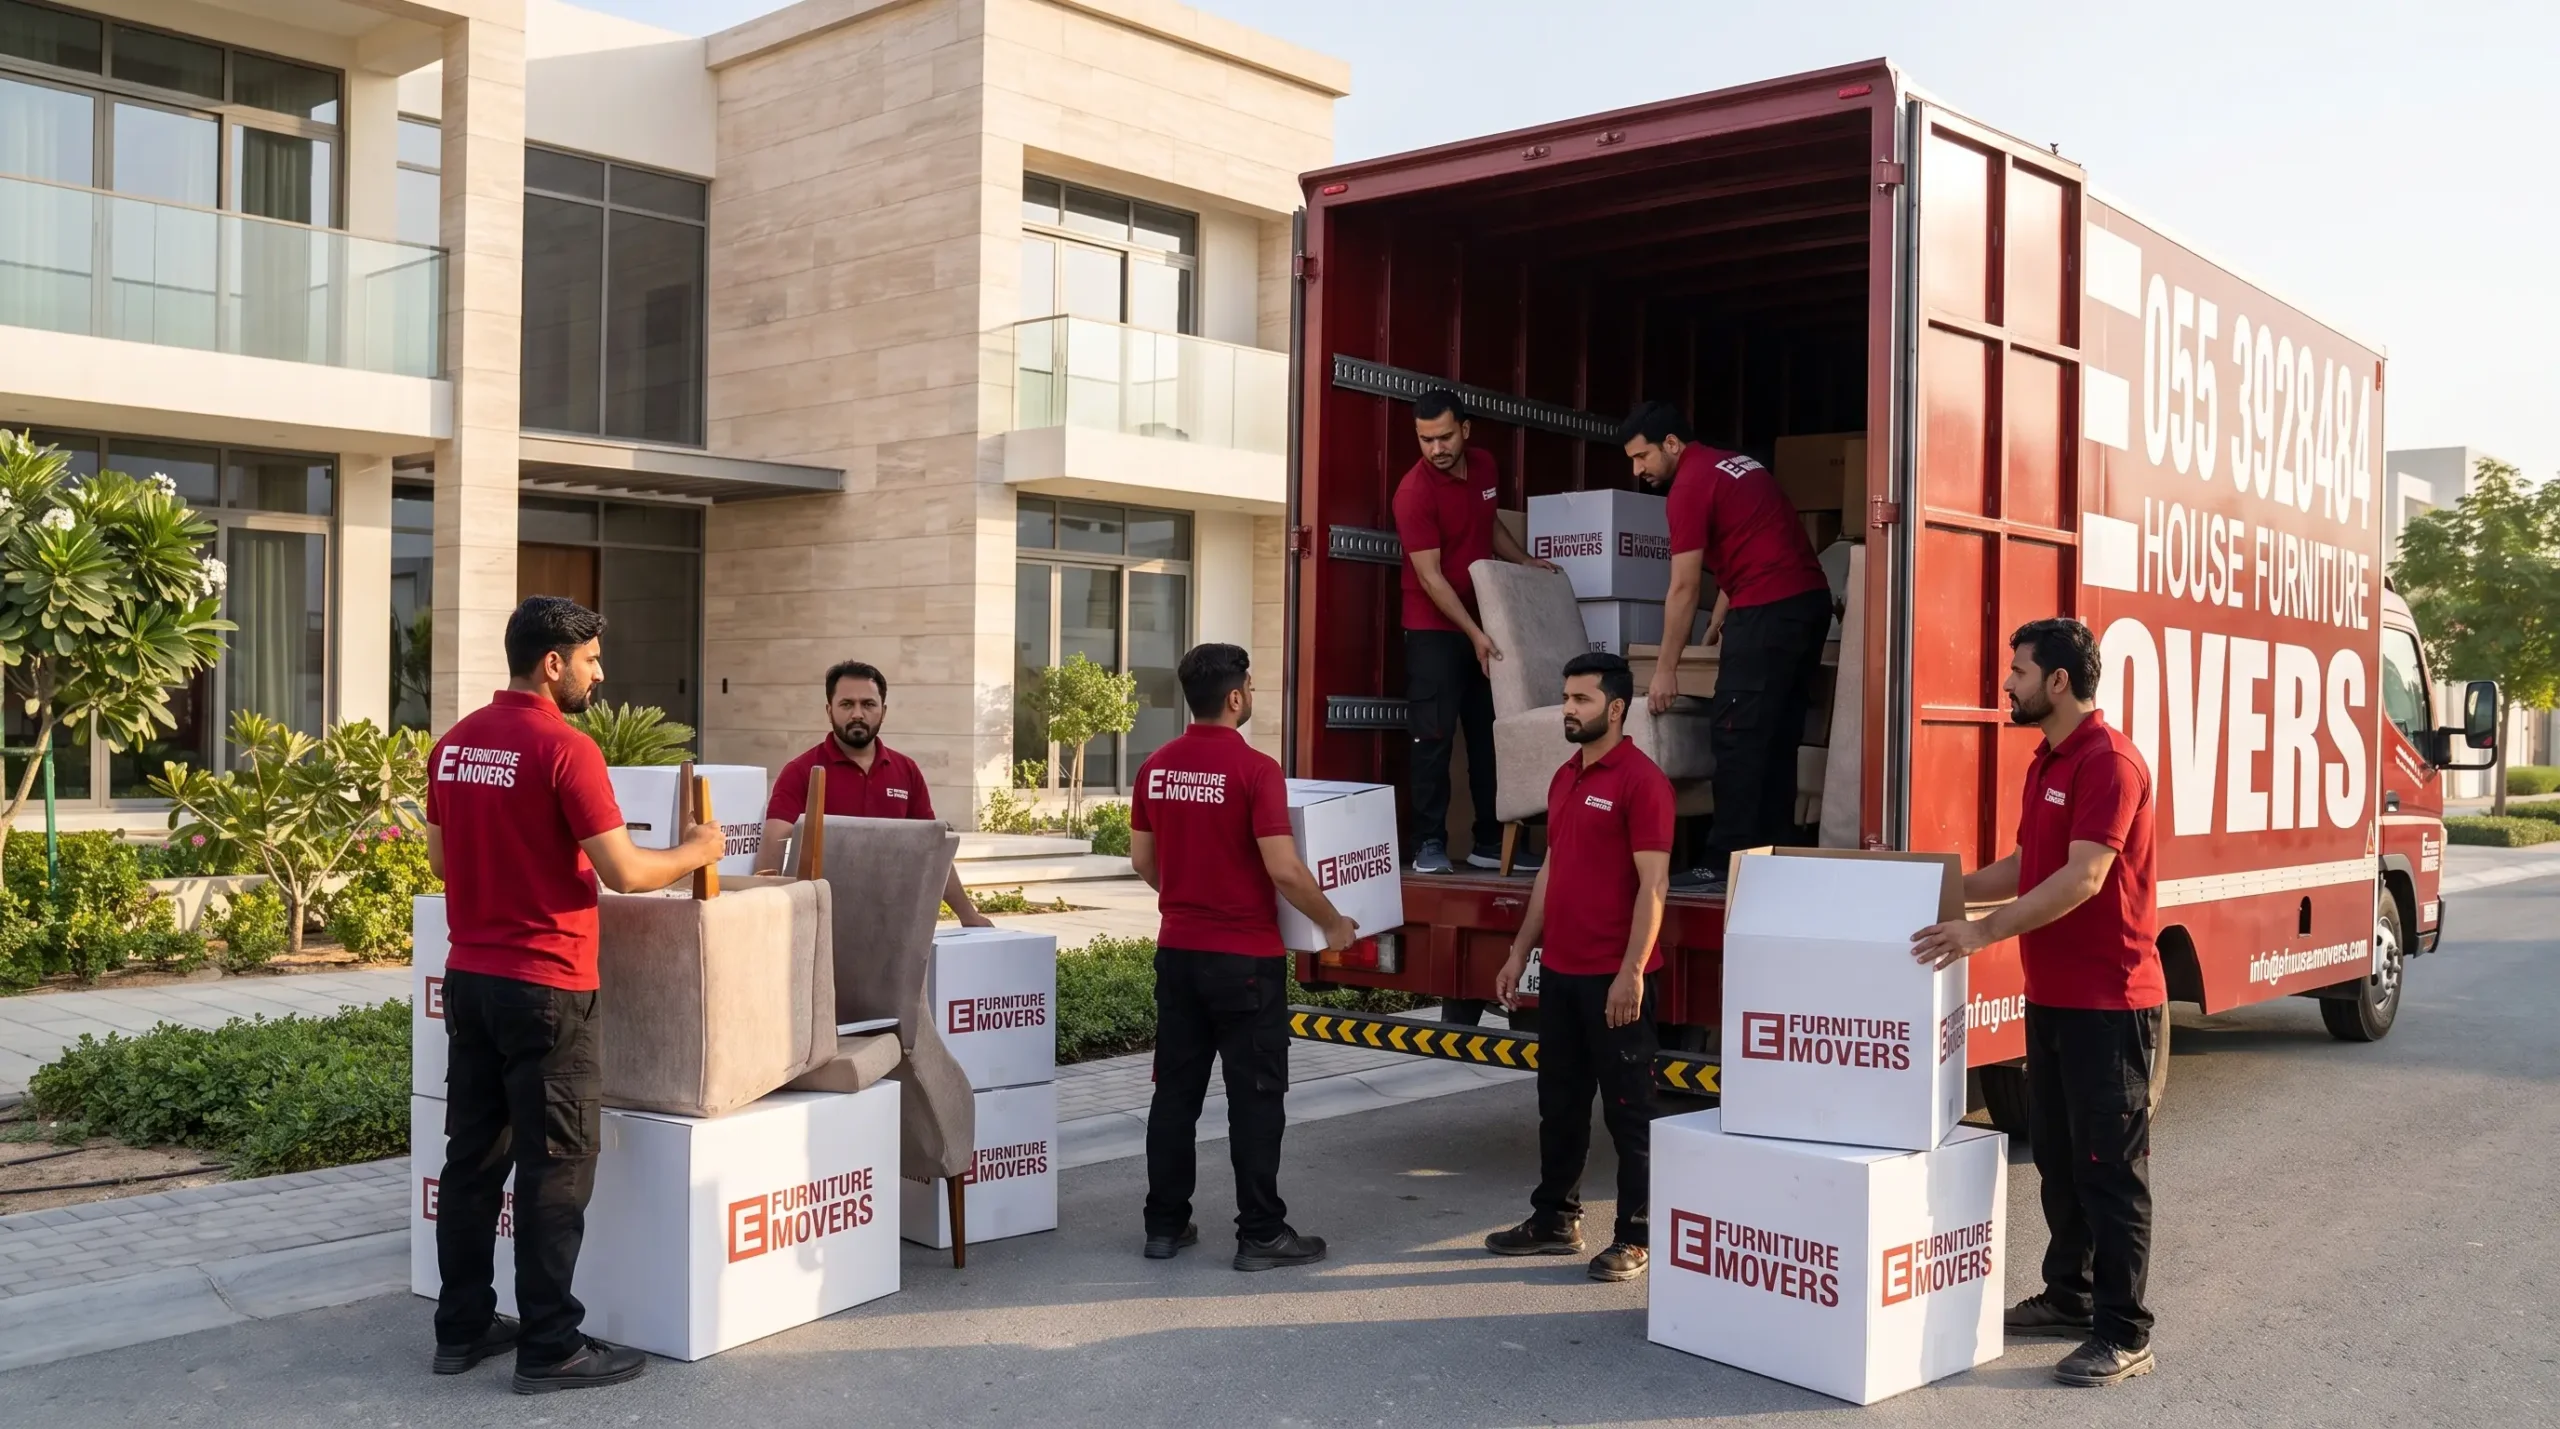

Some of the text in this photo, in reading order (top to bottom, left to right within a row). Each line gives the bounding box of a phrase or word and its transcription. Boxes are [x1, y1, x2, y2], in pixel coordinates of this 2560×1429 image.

[2143, 273, 2218, 481] 055
[2230, 314, 2370, 530] 3928484
[1553, 532, 1603, 545] FURNITURE
[1553, 542, 1603, 558] MOVERS
[2143, 496, 2369, 631] HOUSE FURNITURE
[2095, 617, 2367, 836] OVERS
[438, 745, 460, 781] E
[460, 747, 521, 767] FURNITURE
[457, 763, 516, 788] MOVERS
[1148, 769, 1166, 799] E
[1167, 770, 1226, 787] FURNITURE
[1165, 784, 1224, 804] MOVERS
[1339, 843, 1390, 867] FURNITURE
[1340, 856, 1392, 886] MOVERS
[977, 993, 1045, 1011] FURNITURE
[977, 1008, 1046, 1031] MOVERS
[1789, 1014, 1910, 1041] FURNITURE
[1789, 1037, 1910, 1071] MOVERS
[980, 1141, 1047, 1163] FURNITURE
[980, 1156, 1047, 1185] MOVERS
[772, 1167, 873, 1215] FURNITURE
[772, 1194, 873, 1251] MOVERS
[1715, 1219, 1839, 1271] FURNITURE
[1915, 1220, 1993, 1263] FURNITURE
[1715, 1247, 1839, 1308] MOVERS
[1915, 1246, 1993, 1297] MOVERS
